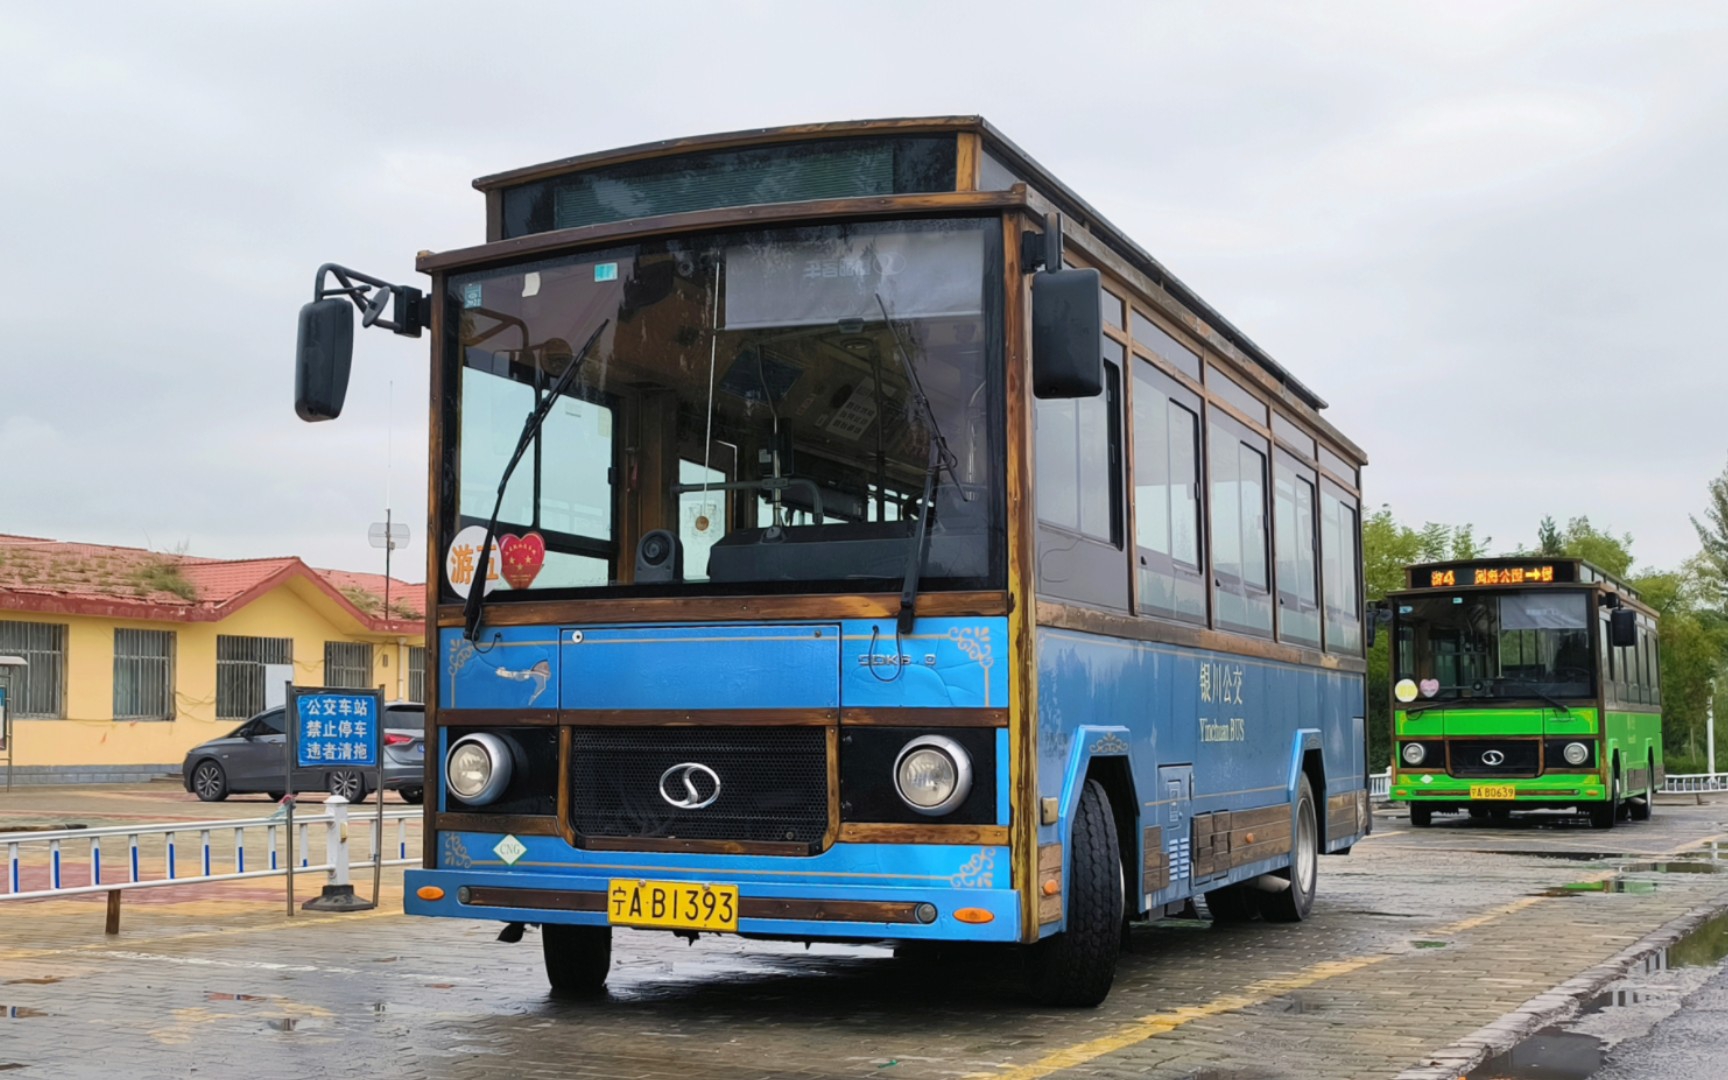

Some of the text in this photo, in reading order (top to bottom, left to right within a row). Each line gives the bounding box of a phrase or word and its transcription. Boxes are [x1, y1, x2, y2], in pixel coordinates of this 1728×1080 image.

[1200, 661, 1243, 705] 银川公交
[306, 698, 368, 716] 公交车站
[306, 720, 368, 738] 禁止停车
[1199, 718, 1245, 742] Yinchuan BUS
[500, 844, 520, 855] CNG
